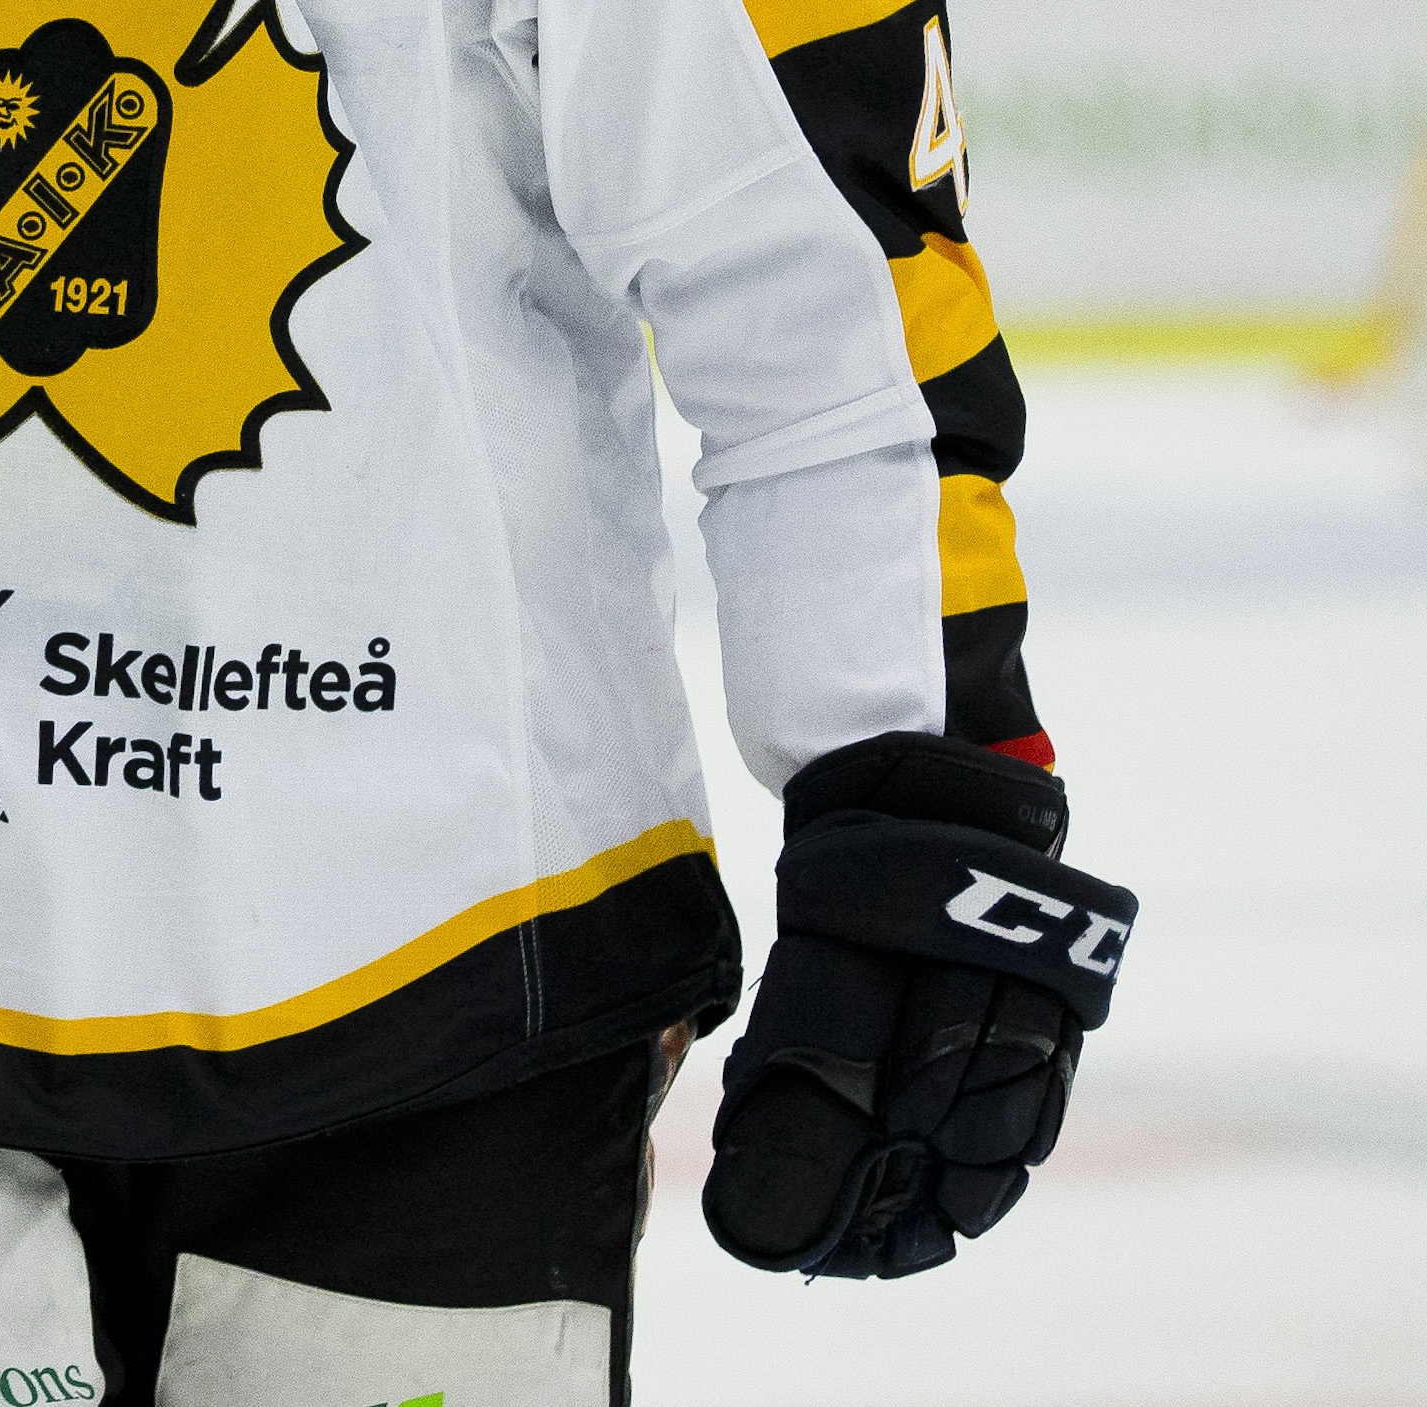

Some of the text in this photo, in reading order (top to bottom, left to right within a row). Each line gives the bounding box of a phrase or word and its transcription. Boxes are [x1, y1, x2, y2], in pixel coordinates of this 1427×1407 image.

[49, 275, 129, 317] 1921
[38, 631, 397, 713] Skellefteå
[37, 720, 222, 802] Kraft
